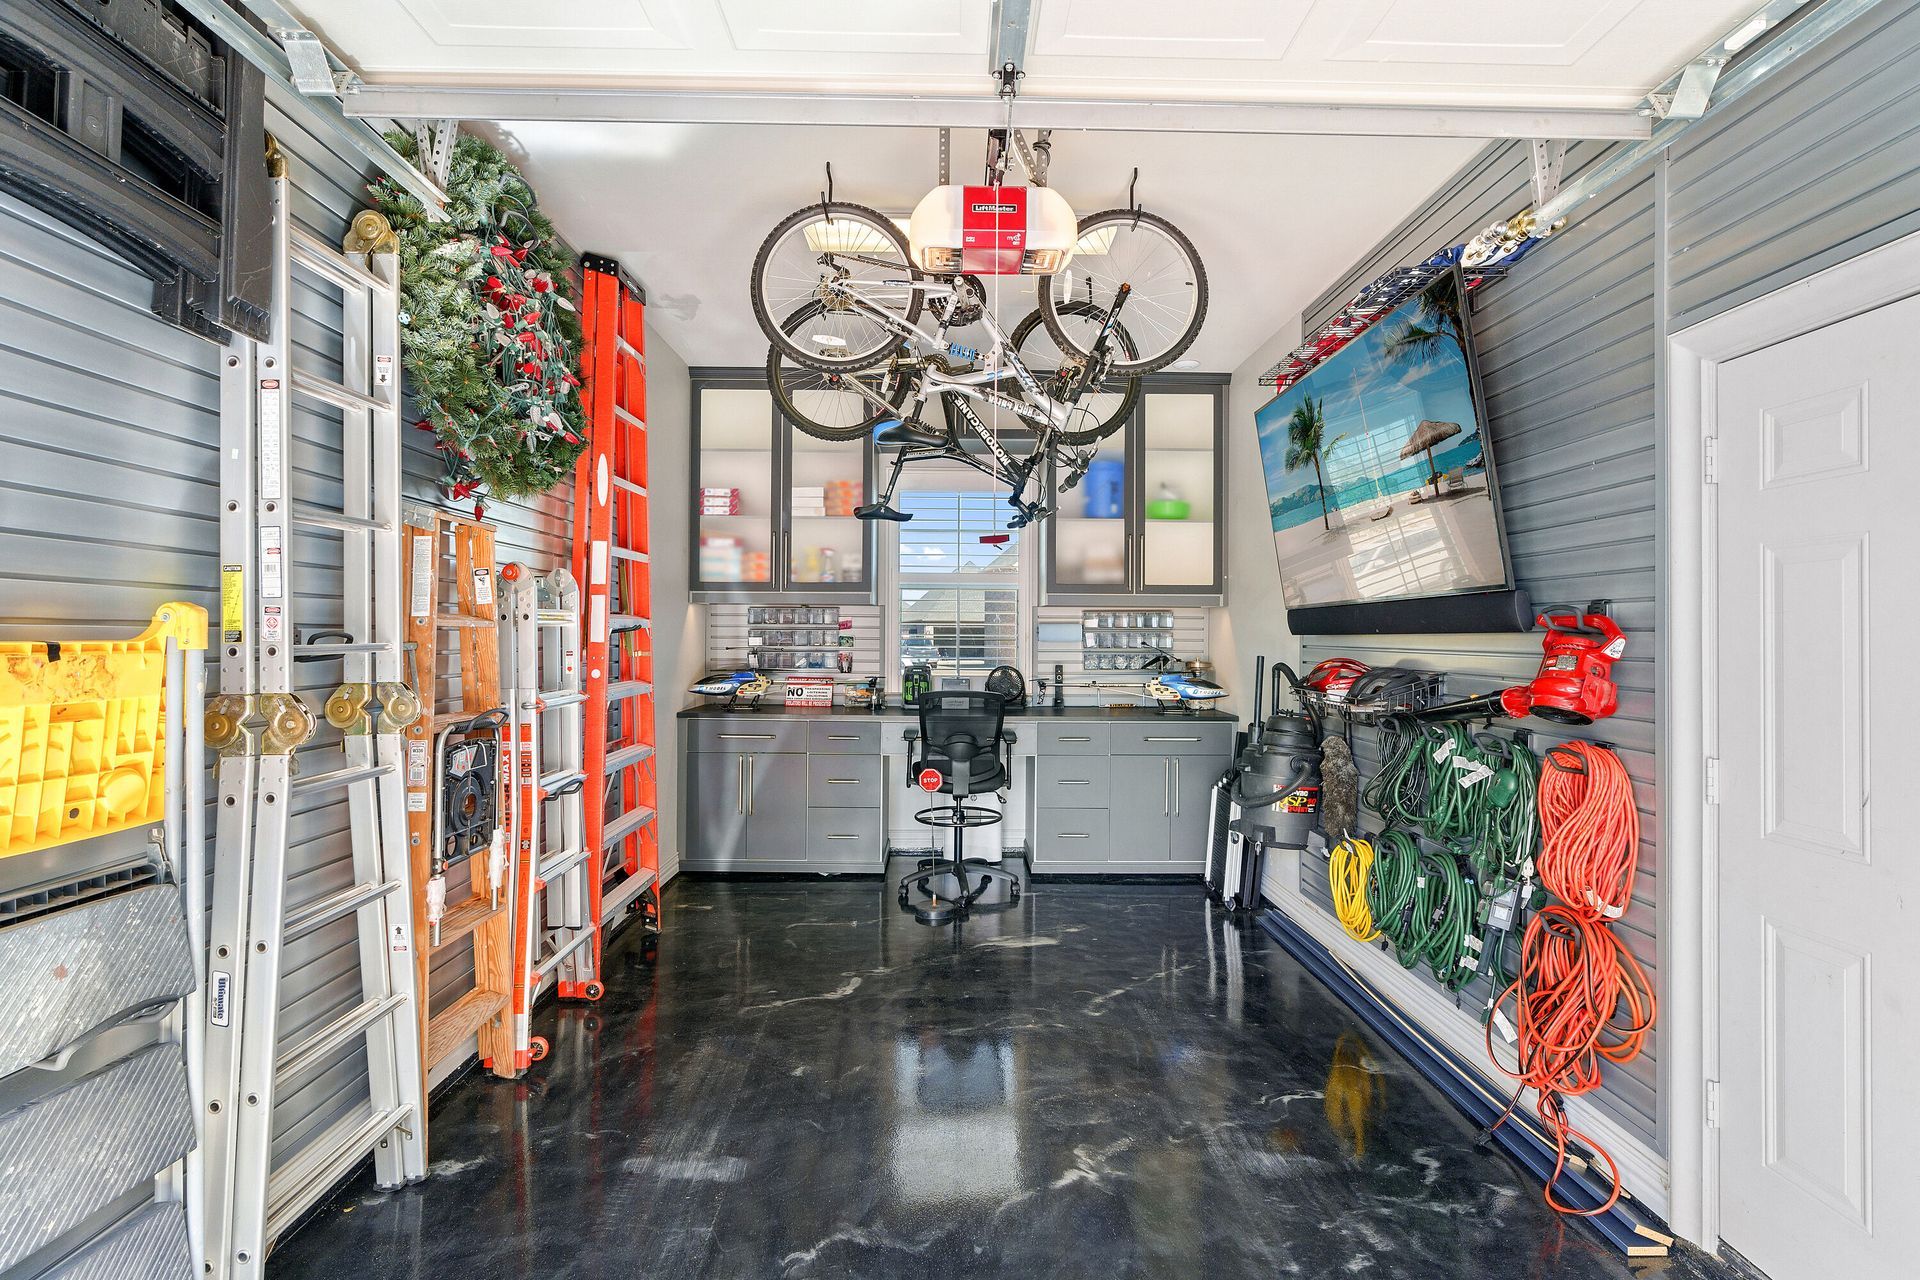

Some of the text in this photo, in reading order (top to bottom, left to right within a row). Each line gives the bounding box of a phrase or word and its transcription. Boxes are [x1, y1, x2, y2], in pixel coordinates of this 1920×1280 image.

[952, 398, 1012, 467] MOTOBECANE
[787, 686, 804, 697] NO
[218, 978, 226, 1019] Ultimate
